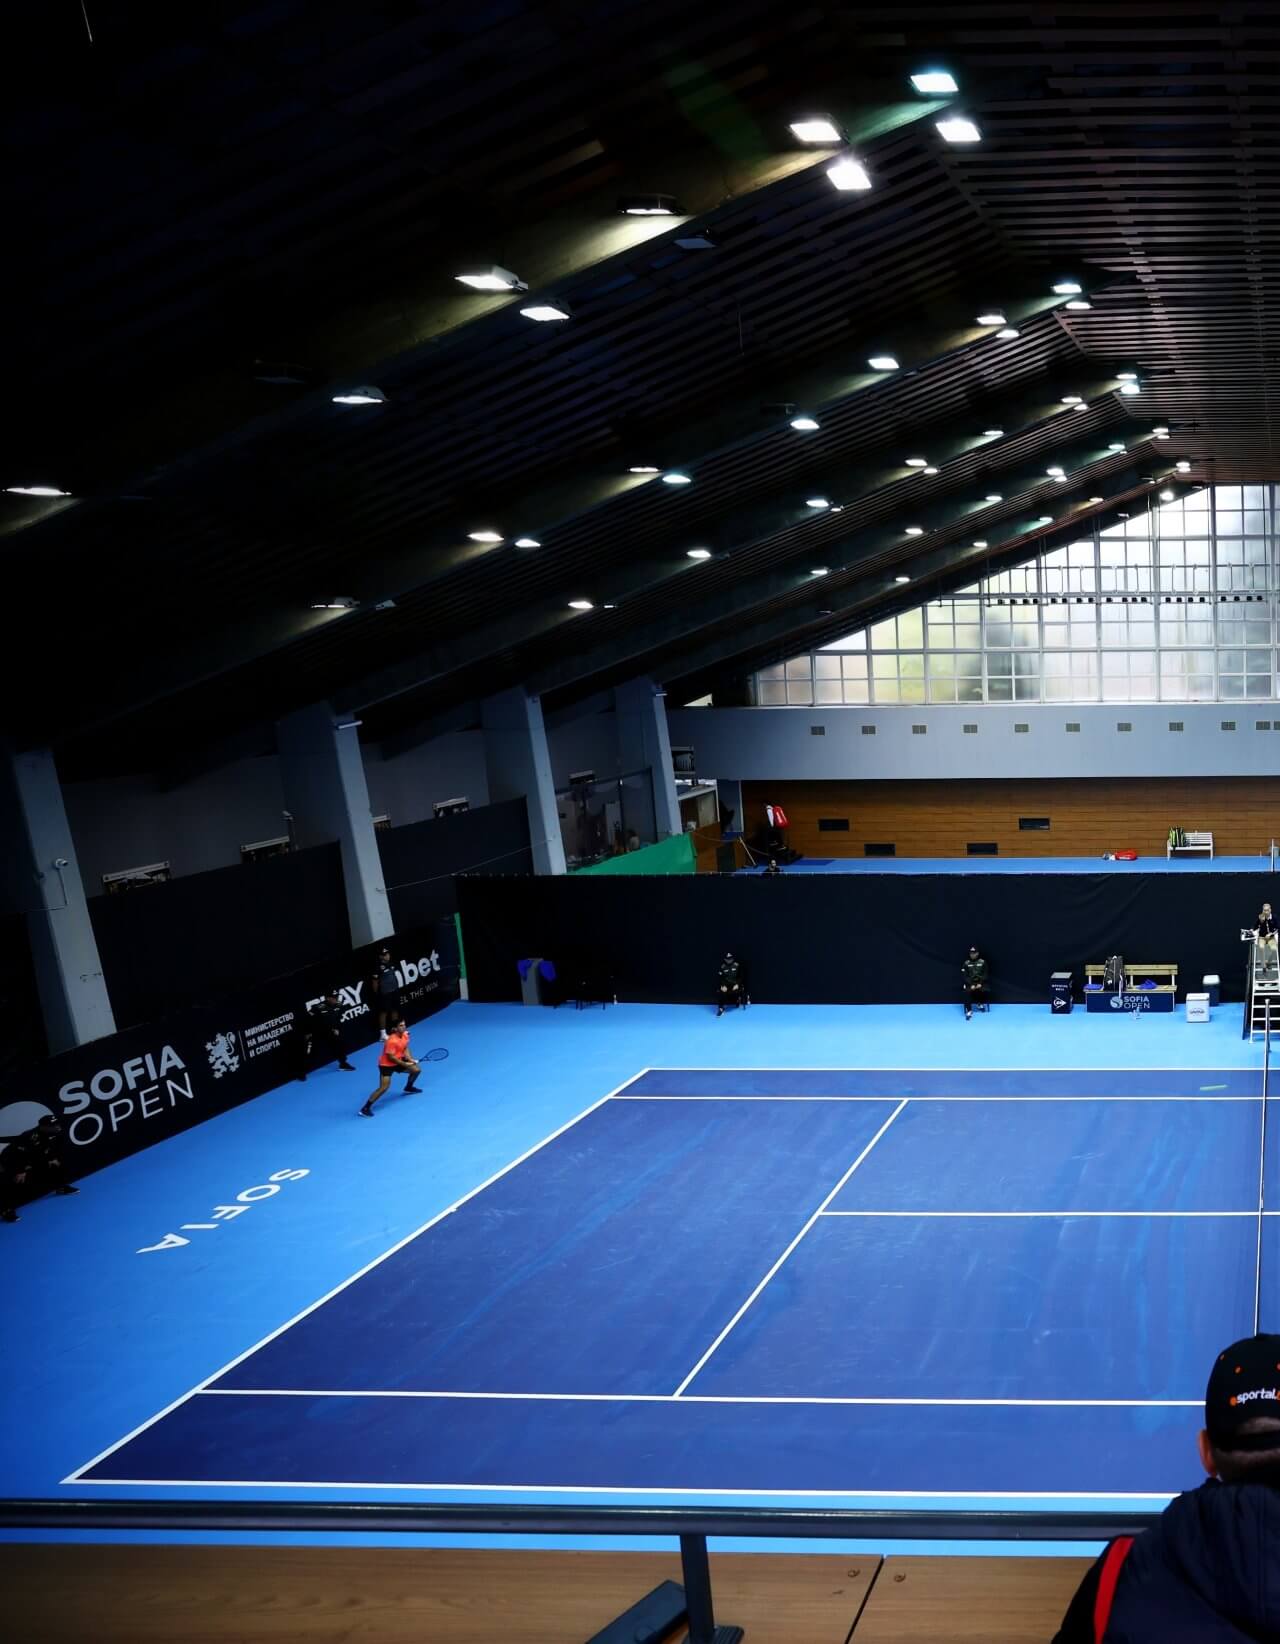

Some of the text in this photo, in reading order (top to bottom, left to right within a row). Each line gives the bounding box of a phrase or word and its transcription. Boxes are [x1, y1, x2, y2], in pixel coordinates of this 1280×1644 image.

[59, 1044, 186, 1115] SOFIA
[69, 1072, 194, 1146] OPEN
[135, 1168, 310, 1254] SOFIA
